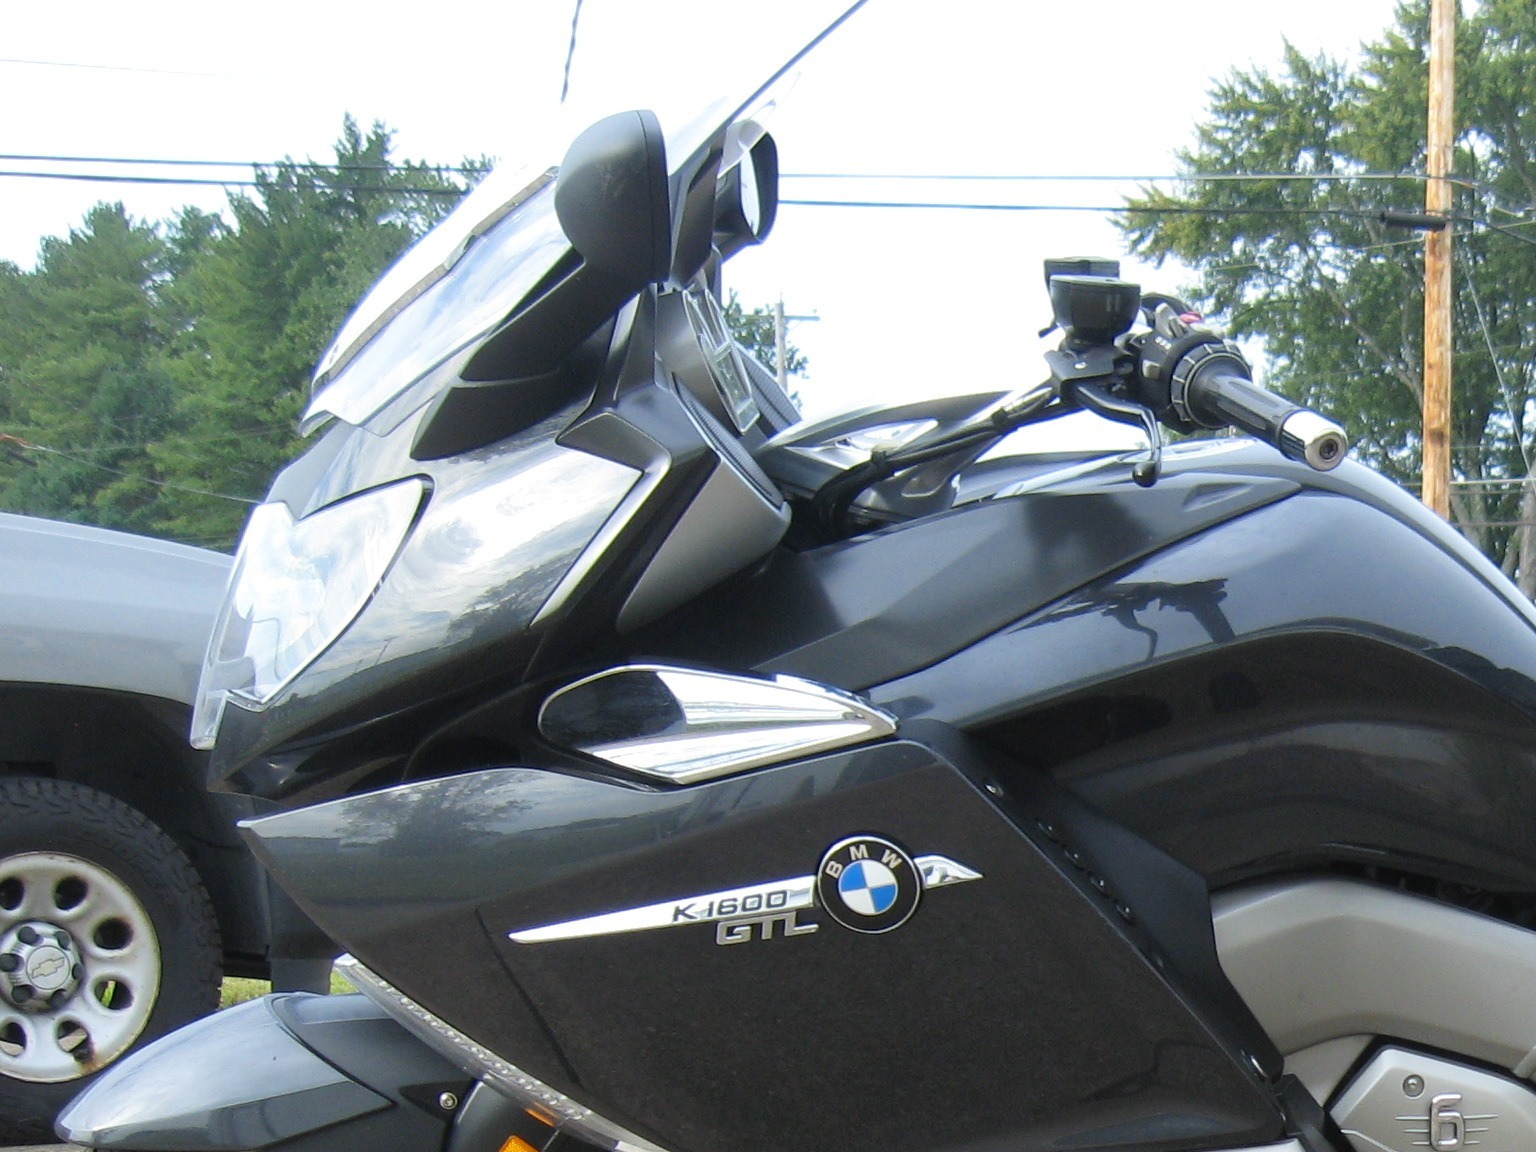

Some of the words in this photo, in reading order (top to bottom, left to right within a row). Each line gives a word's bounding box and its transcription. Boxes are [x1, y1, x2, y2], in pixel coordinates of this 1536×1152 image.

[825, 844, 902, 879] BMW
[672, 903, 698, 922] K
[706, 890, 788, 918] 1600
[716, 911, 819, 945] GTL
